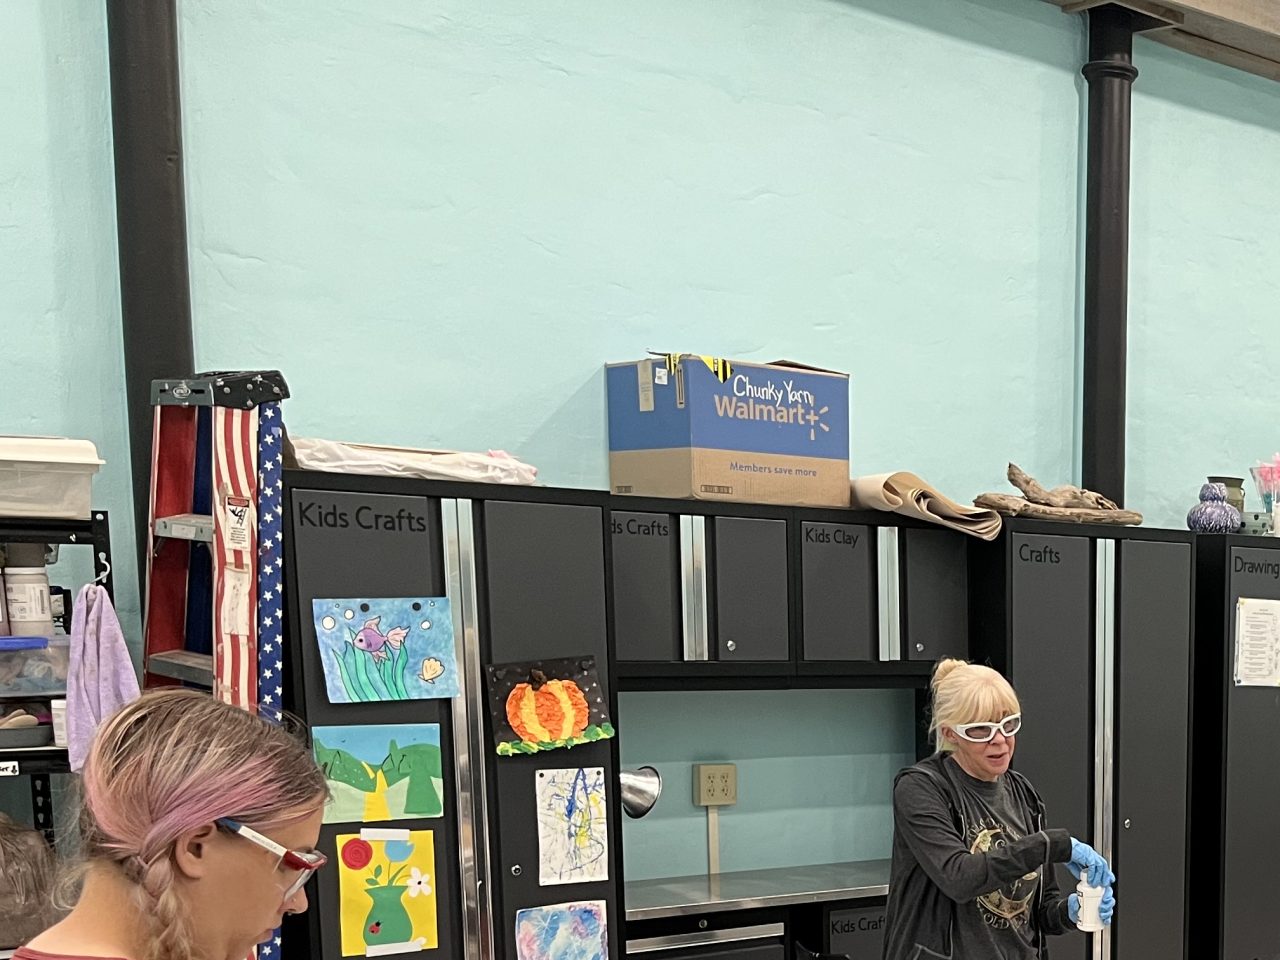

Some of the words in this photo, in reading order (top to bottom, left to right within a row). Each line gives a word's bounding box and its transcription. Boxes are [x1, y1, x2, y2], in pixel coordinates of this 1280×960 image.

[733, 374, 784, 408] Chunky
[783, 380, 812, 405] Yarn
[730, 462, 772, 474] Members
[774, 467, 793, 476] save
[795, 469, 817, 478] more
[299, 502, 350, 529] Kids
[354, 506, 427, 533] Crafts
[627, 520, 669, 537] Crafts
[805, 527, 831, 545] Kids
[834, 529, 859, 549] Clay
[1019, 544, 1061, 564] Crafts
[1234, 556, 1280, 579] Drawing
[831, 919, 855, 935] Kids
[858, 916, 886, 931] Craf
